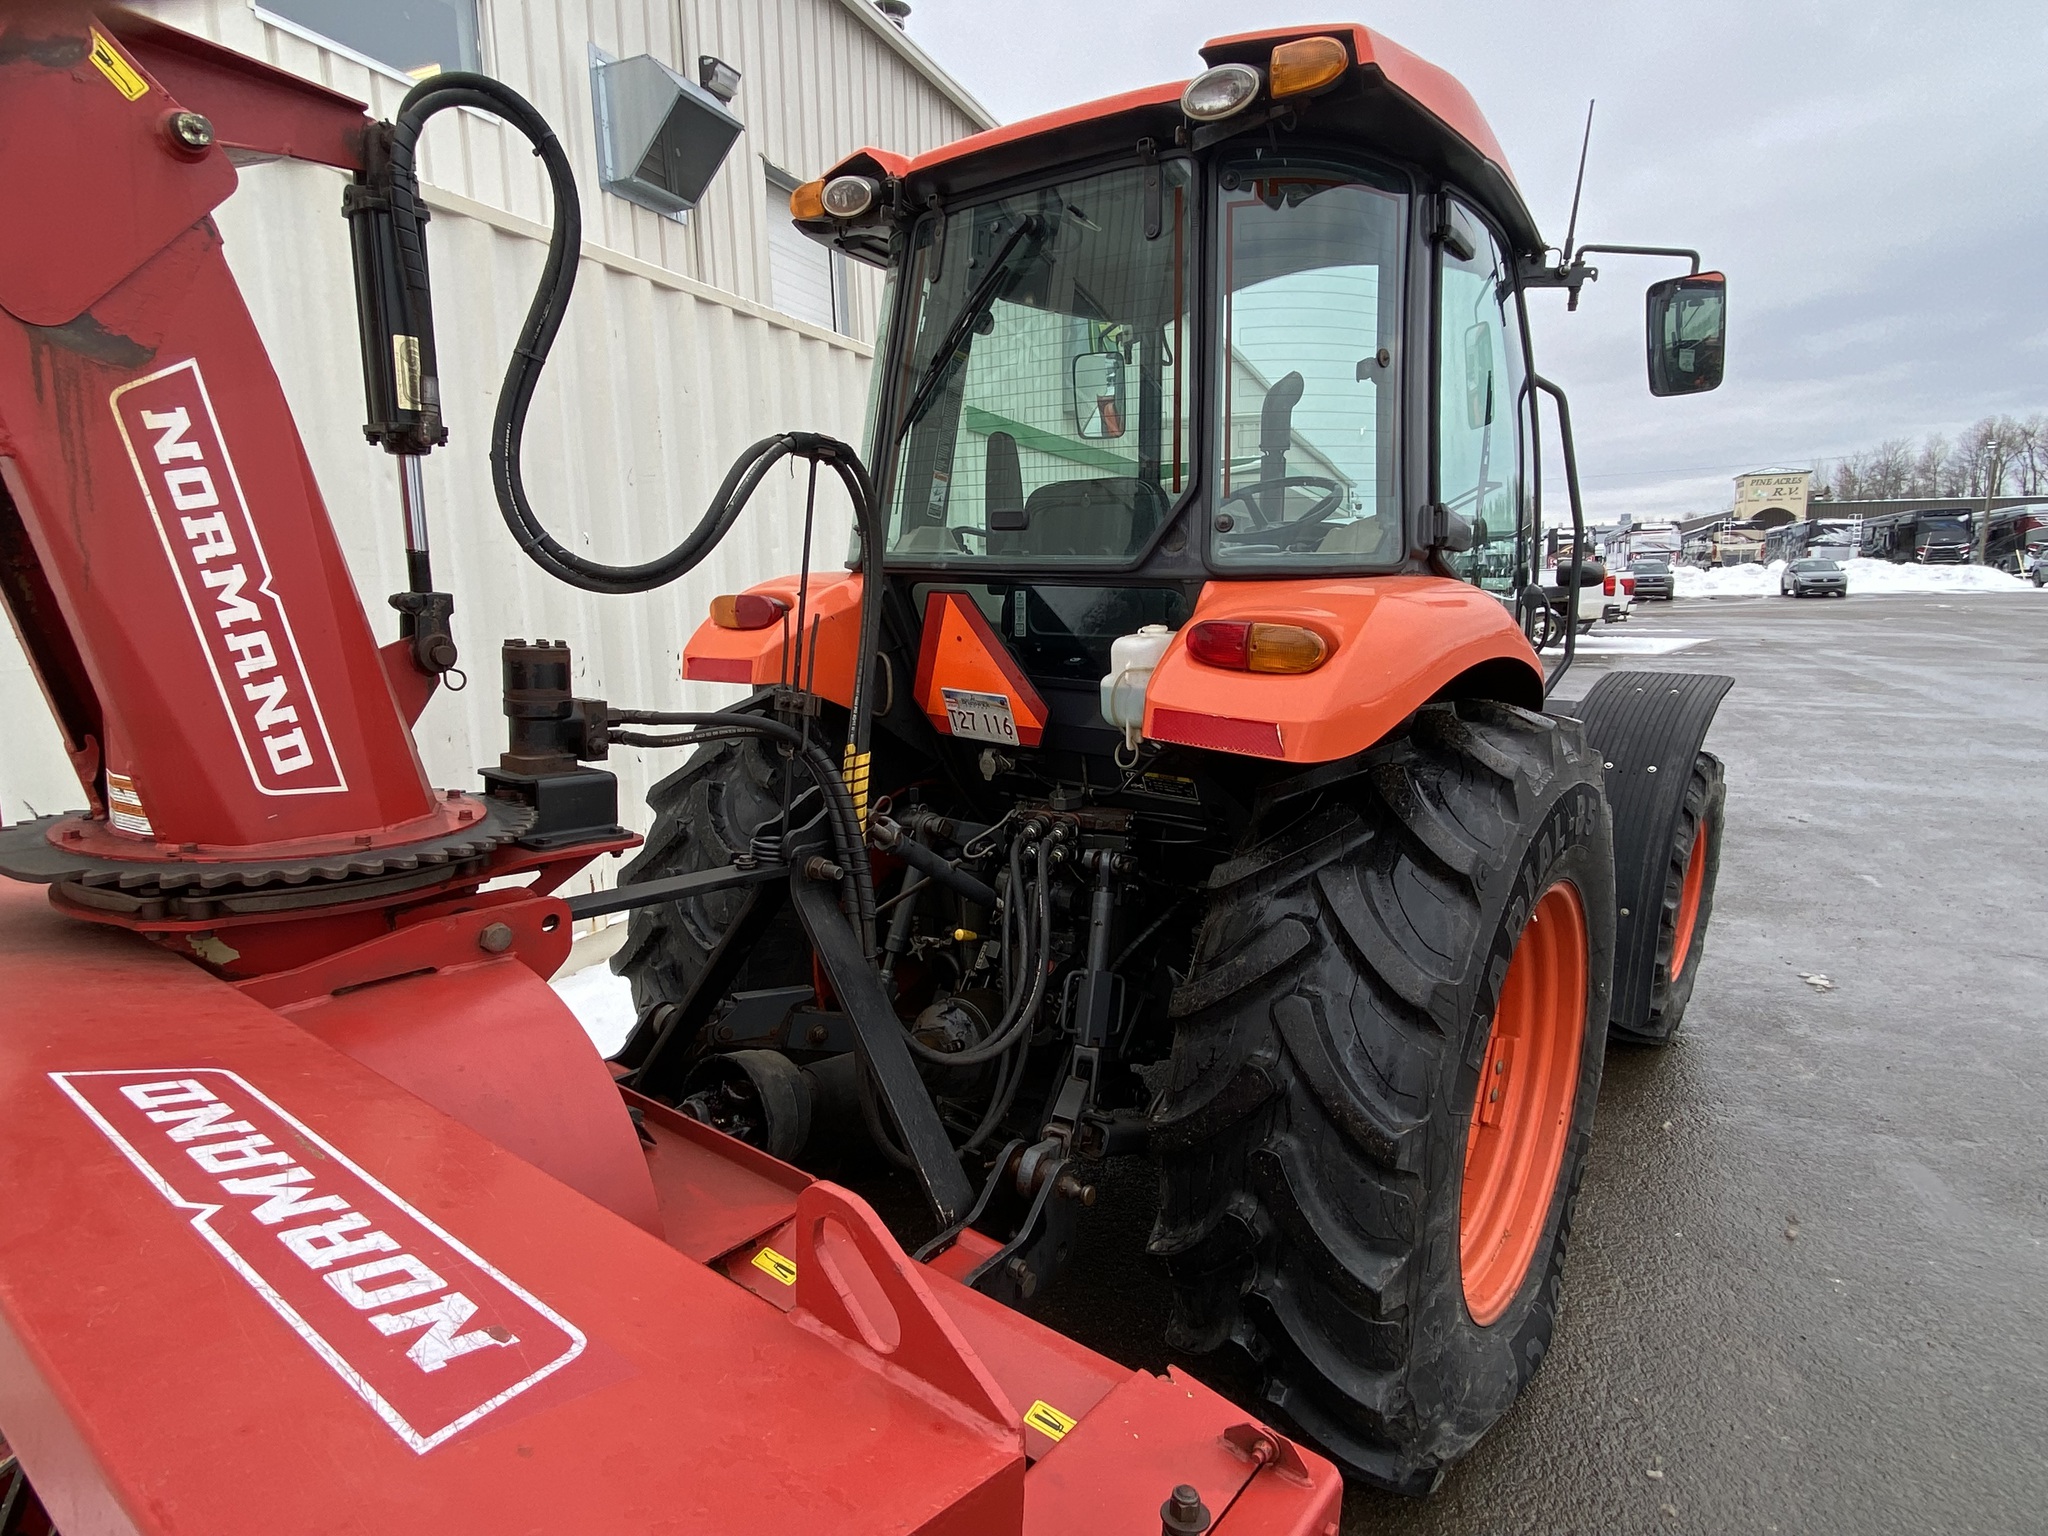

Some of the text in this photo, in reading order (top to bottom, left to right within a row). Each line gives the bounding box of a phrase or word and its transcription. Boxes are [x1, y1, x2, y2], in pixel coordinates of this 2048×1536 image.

[1773, 477, 1802, 485] ACRES
[140, 405, 314, 776] NORMAND
[947, 708, 1014, 737] T27 116
[119, 1077, 521, 1374] NORMAND
